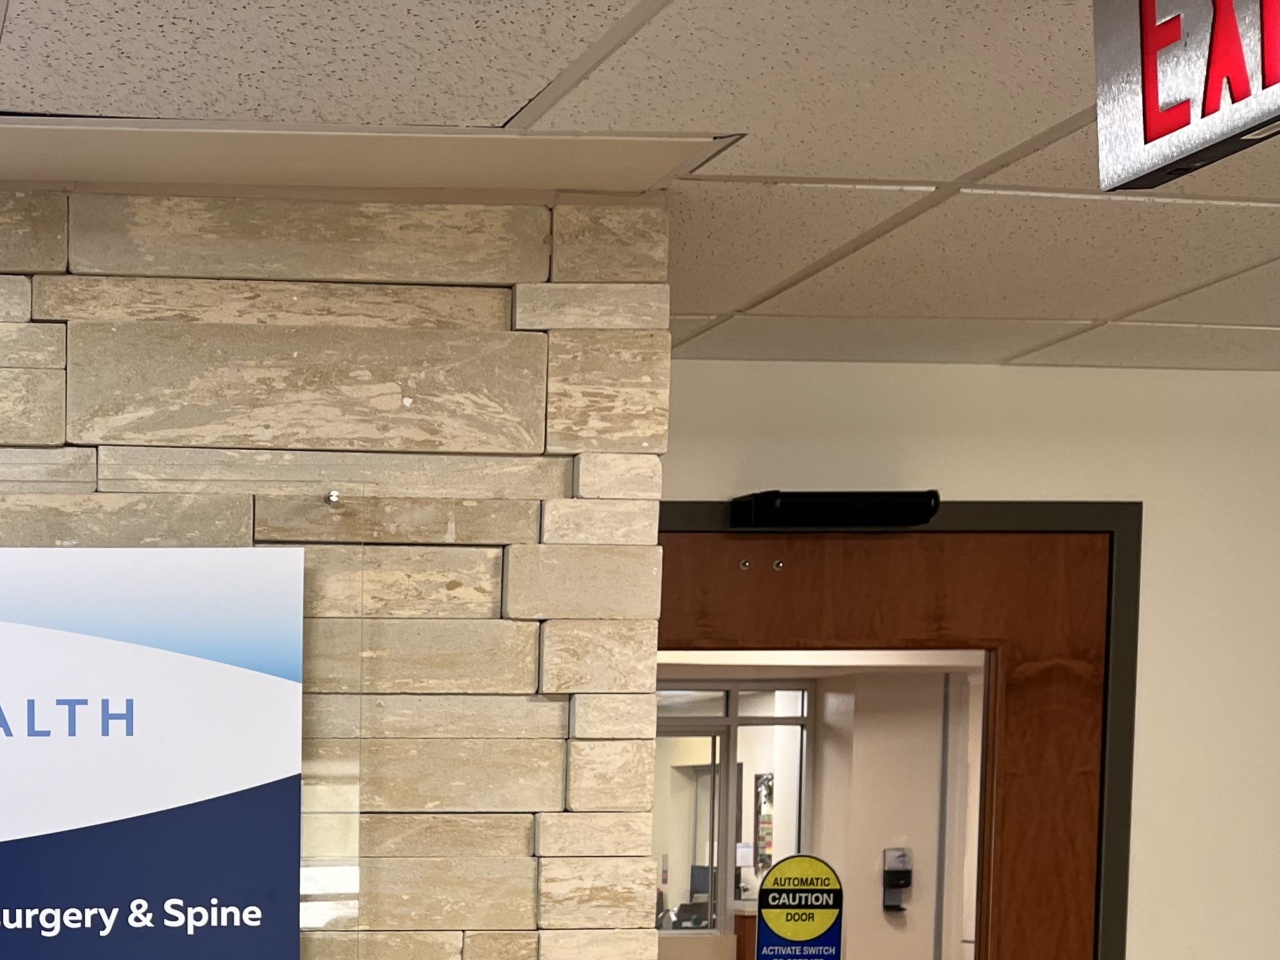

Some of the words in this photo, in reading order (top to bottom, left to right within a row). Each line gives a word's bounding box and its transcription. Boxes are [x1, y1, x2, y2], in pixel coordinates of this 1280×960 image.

[773, 877, 831, 886] AUTOMATIC
[768, 893, 834, 906] CAUTION
[127, 898, 155, 928] &
[163, 897, 262, 936] Spine
[786, 912, 815, 922] DOOR
[762, 946, 801, 955] ACTIVATE
[803, 946, 835, 955] SWITCH
